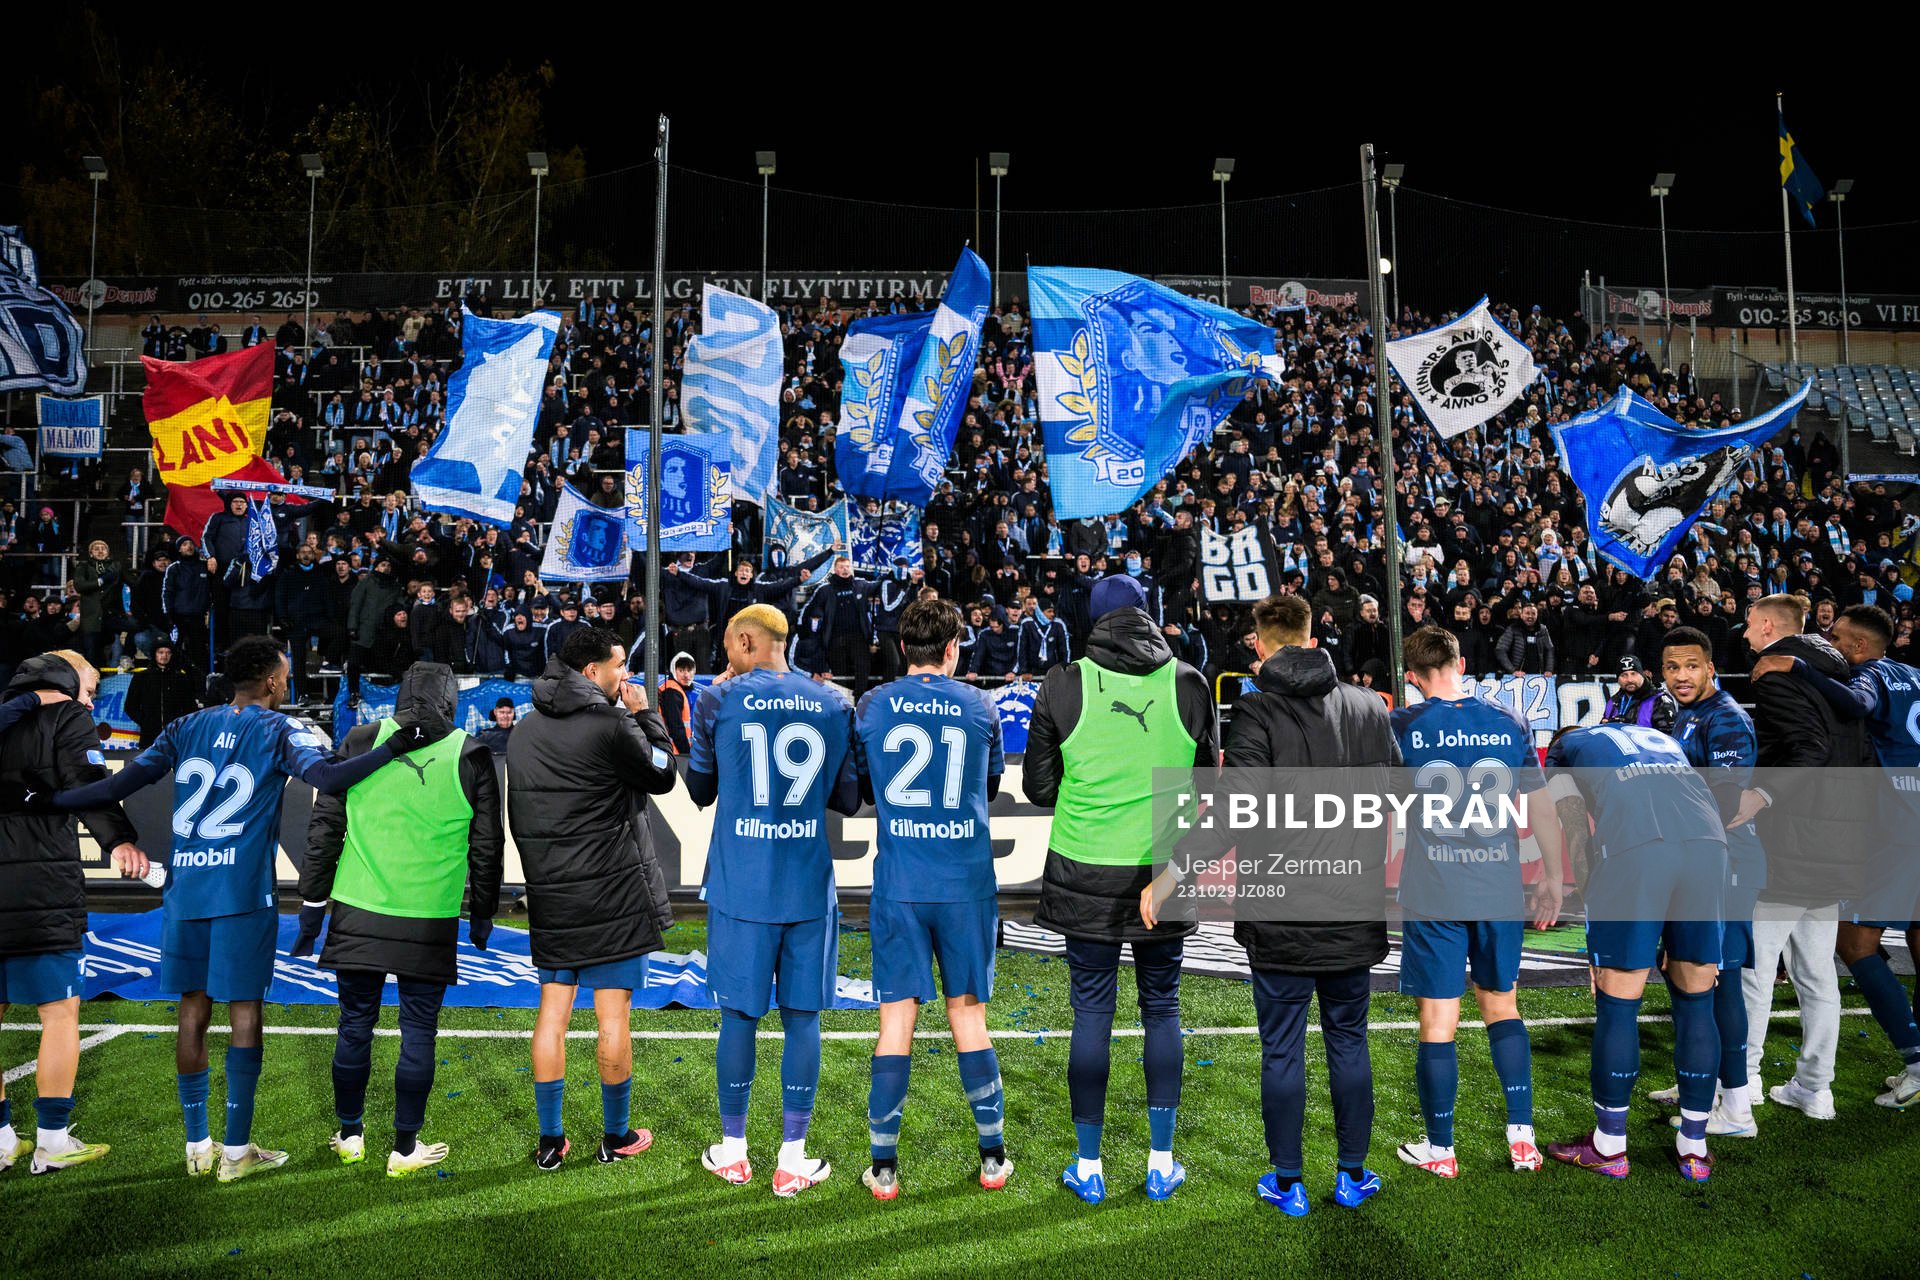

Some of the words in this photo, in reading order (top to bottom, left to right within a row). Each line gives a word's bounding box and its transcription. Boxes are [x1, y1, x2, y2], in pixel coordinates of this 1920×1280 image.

[436, 279, 491, 298] ETT
[568, 279, 624, 298] ETT
[1250, 285, 1284, 306] Billy
[188, 291, 265, 309] 010-265
[271, 291, 319, 309] 2650
[1876, 304, 1897, 322] VI
[1440, 393, 1489, 410] ANNO
[743, 694, 823, 713] Cornelius
[889, 696, 962, 717] Vecchia
[213, 731, 237, 749] Ali
[1411, 730, 1430, 749] B.
[1436, 729, 1512, 748] Johnsen
[741, 722, 826, 807] 19
[883, 723, 967, 809] 21
[1891, 775, 1920, 792] till
[172, 757, 255, 840] 22
[1414, 757, 1514, 838] 23
[735, 818, 817, 840] tillmobil
[890, 818, 975, 840] tillmobil
